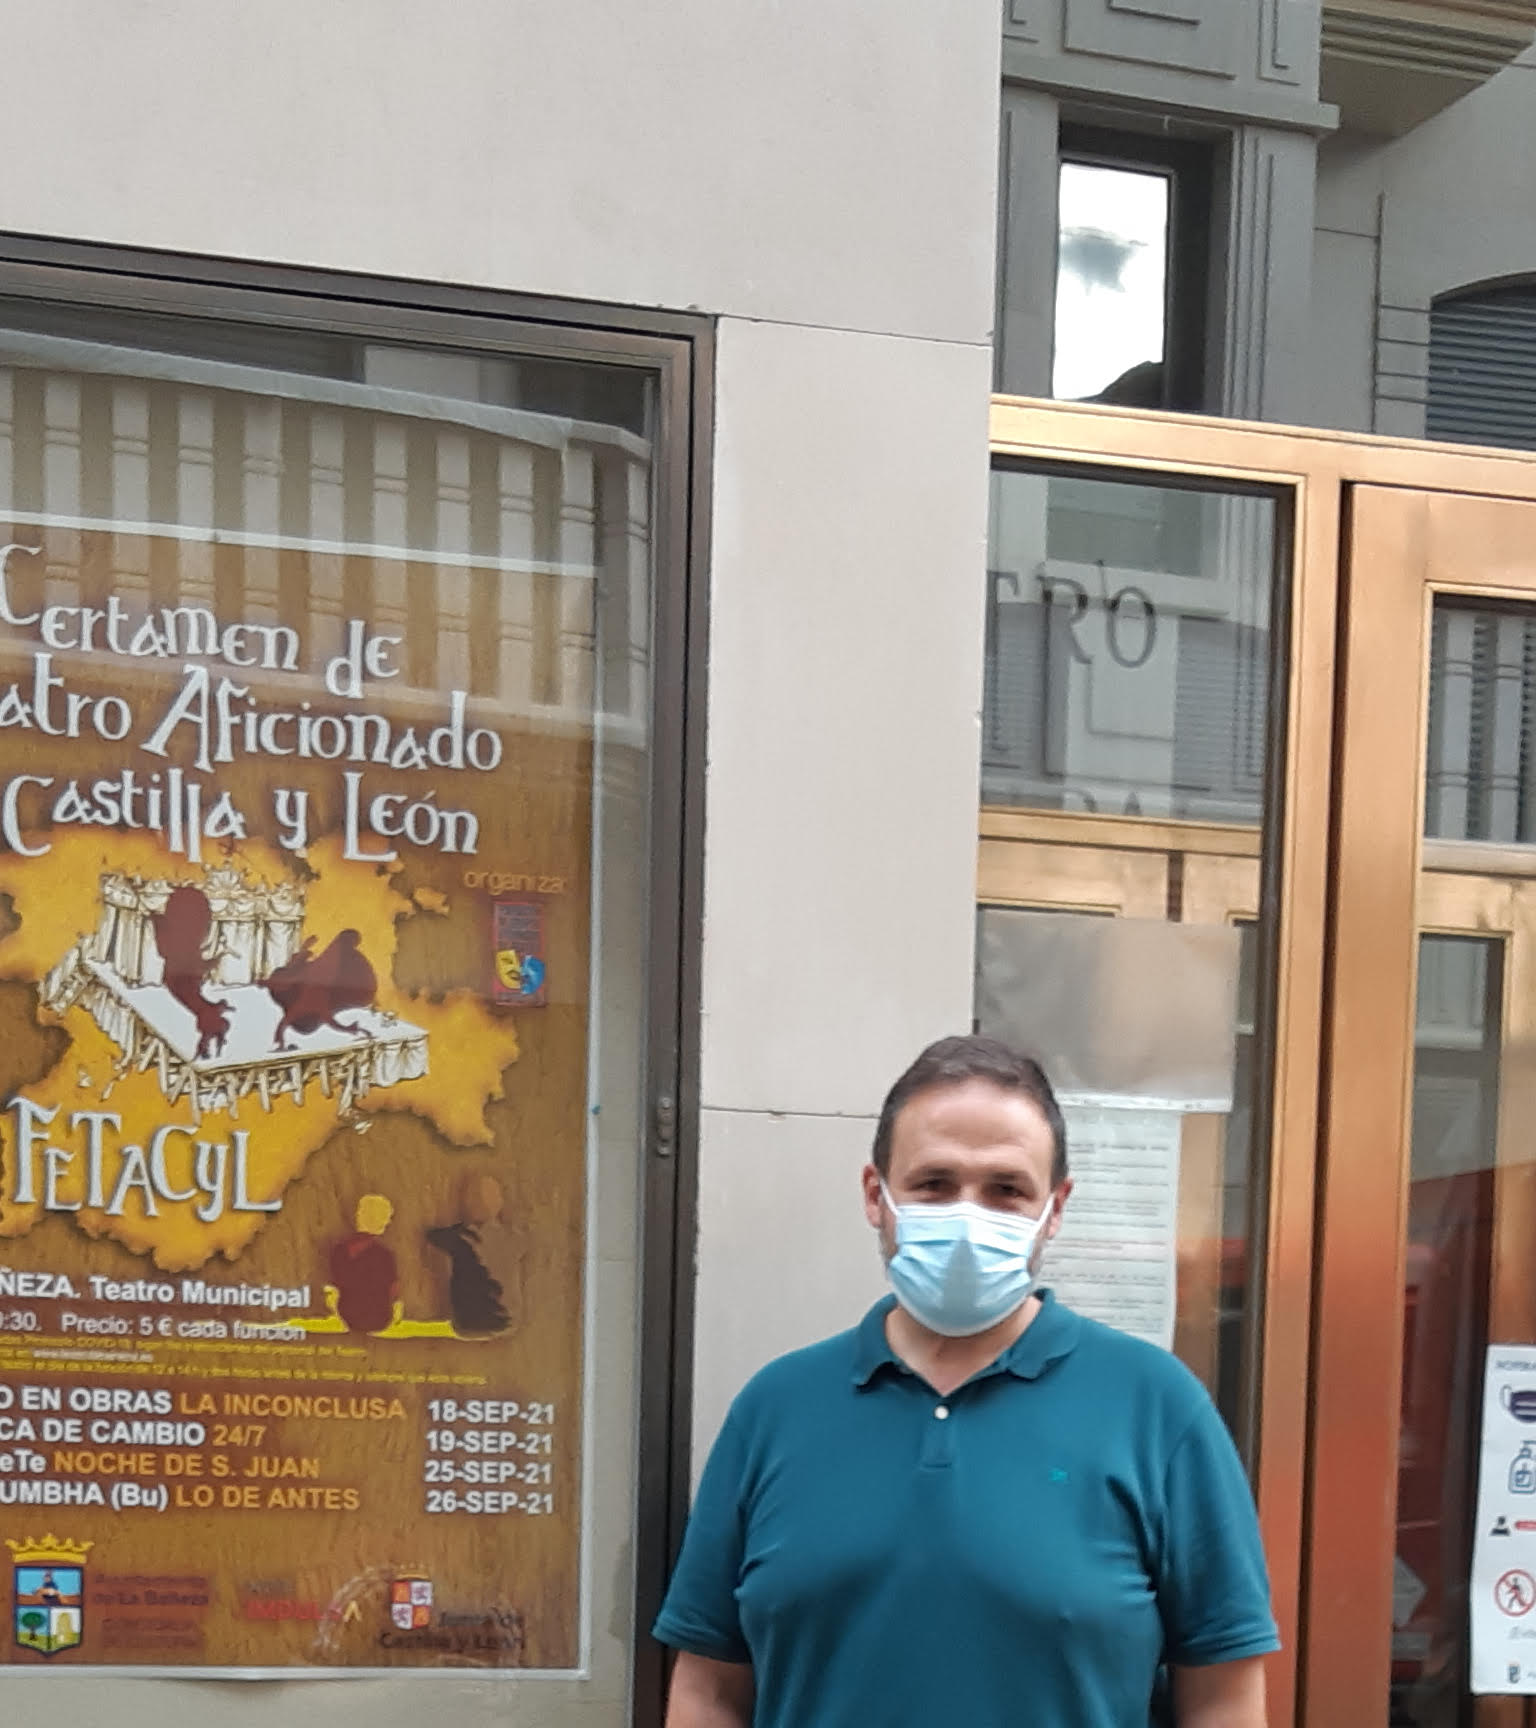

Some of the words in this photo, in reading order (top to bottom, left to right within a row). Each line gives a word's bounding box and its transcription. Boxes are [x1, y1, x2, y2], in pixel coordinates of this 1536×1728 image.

[326, 619, 403, 699] de
[141, 665, 503, 773] Aficionado
[2, 768, 247, 863] Castilla
[275, 788, 309, 850] y
[343, 772, 480, 863] León
[465, 870, 564, 896] organiza
[89, 1275, 174, 1303] Teatro
[182, 1279, 311, 1311] Municipal
[61, 1313, 133, 1336] Precio:
[139, 1317, 154, 1335] 5
[157, 1317, 175, 1336] €
[178, 1320, 228, 1338] cada
[21, 1387, 62, 1411] EN
[69, 1387, 172, 1415] OBRAS
[179, 1392, 217, 1416] LA
[223, 1393, 408, 1420] INCONCLUSA
[427, 1399, 554, 1425] 18-SEP-21
[42, 1418, 83, 1443] DE
[90, 1420, 206, 1447] CAMBIO
[213, 1424, 267, 1448] 24/7
[425, 1429, 553, 1455] 19-SEP-21
[54, 1450, 158, 1475] NOCHE
[166, 1453, 204, 1477] DE
[210, 1456, 236, 1478] S.
[244, 1456, 321, 1479] JUAN
[424, 1459, 552, 1485] 25-SEP-21
[110, 1482, 169, 1511] (Bu)
[176, 1484, 213, 1508] LO
[222, 1485, 263, 1509] DE
[267, 1487, 361, 1511] ANTES
[425, 1489, 554, 1514] 26-SEP-21
